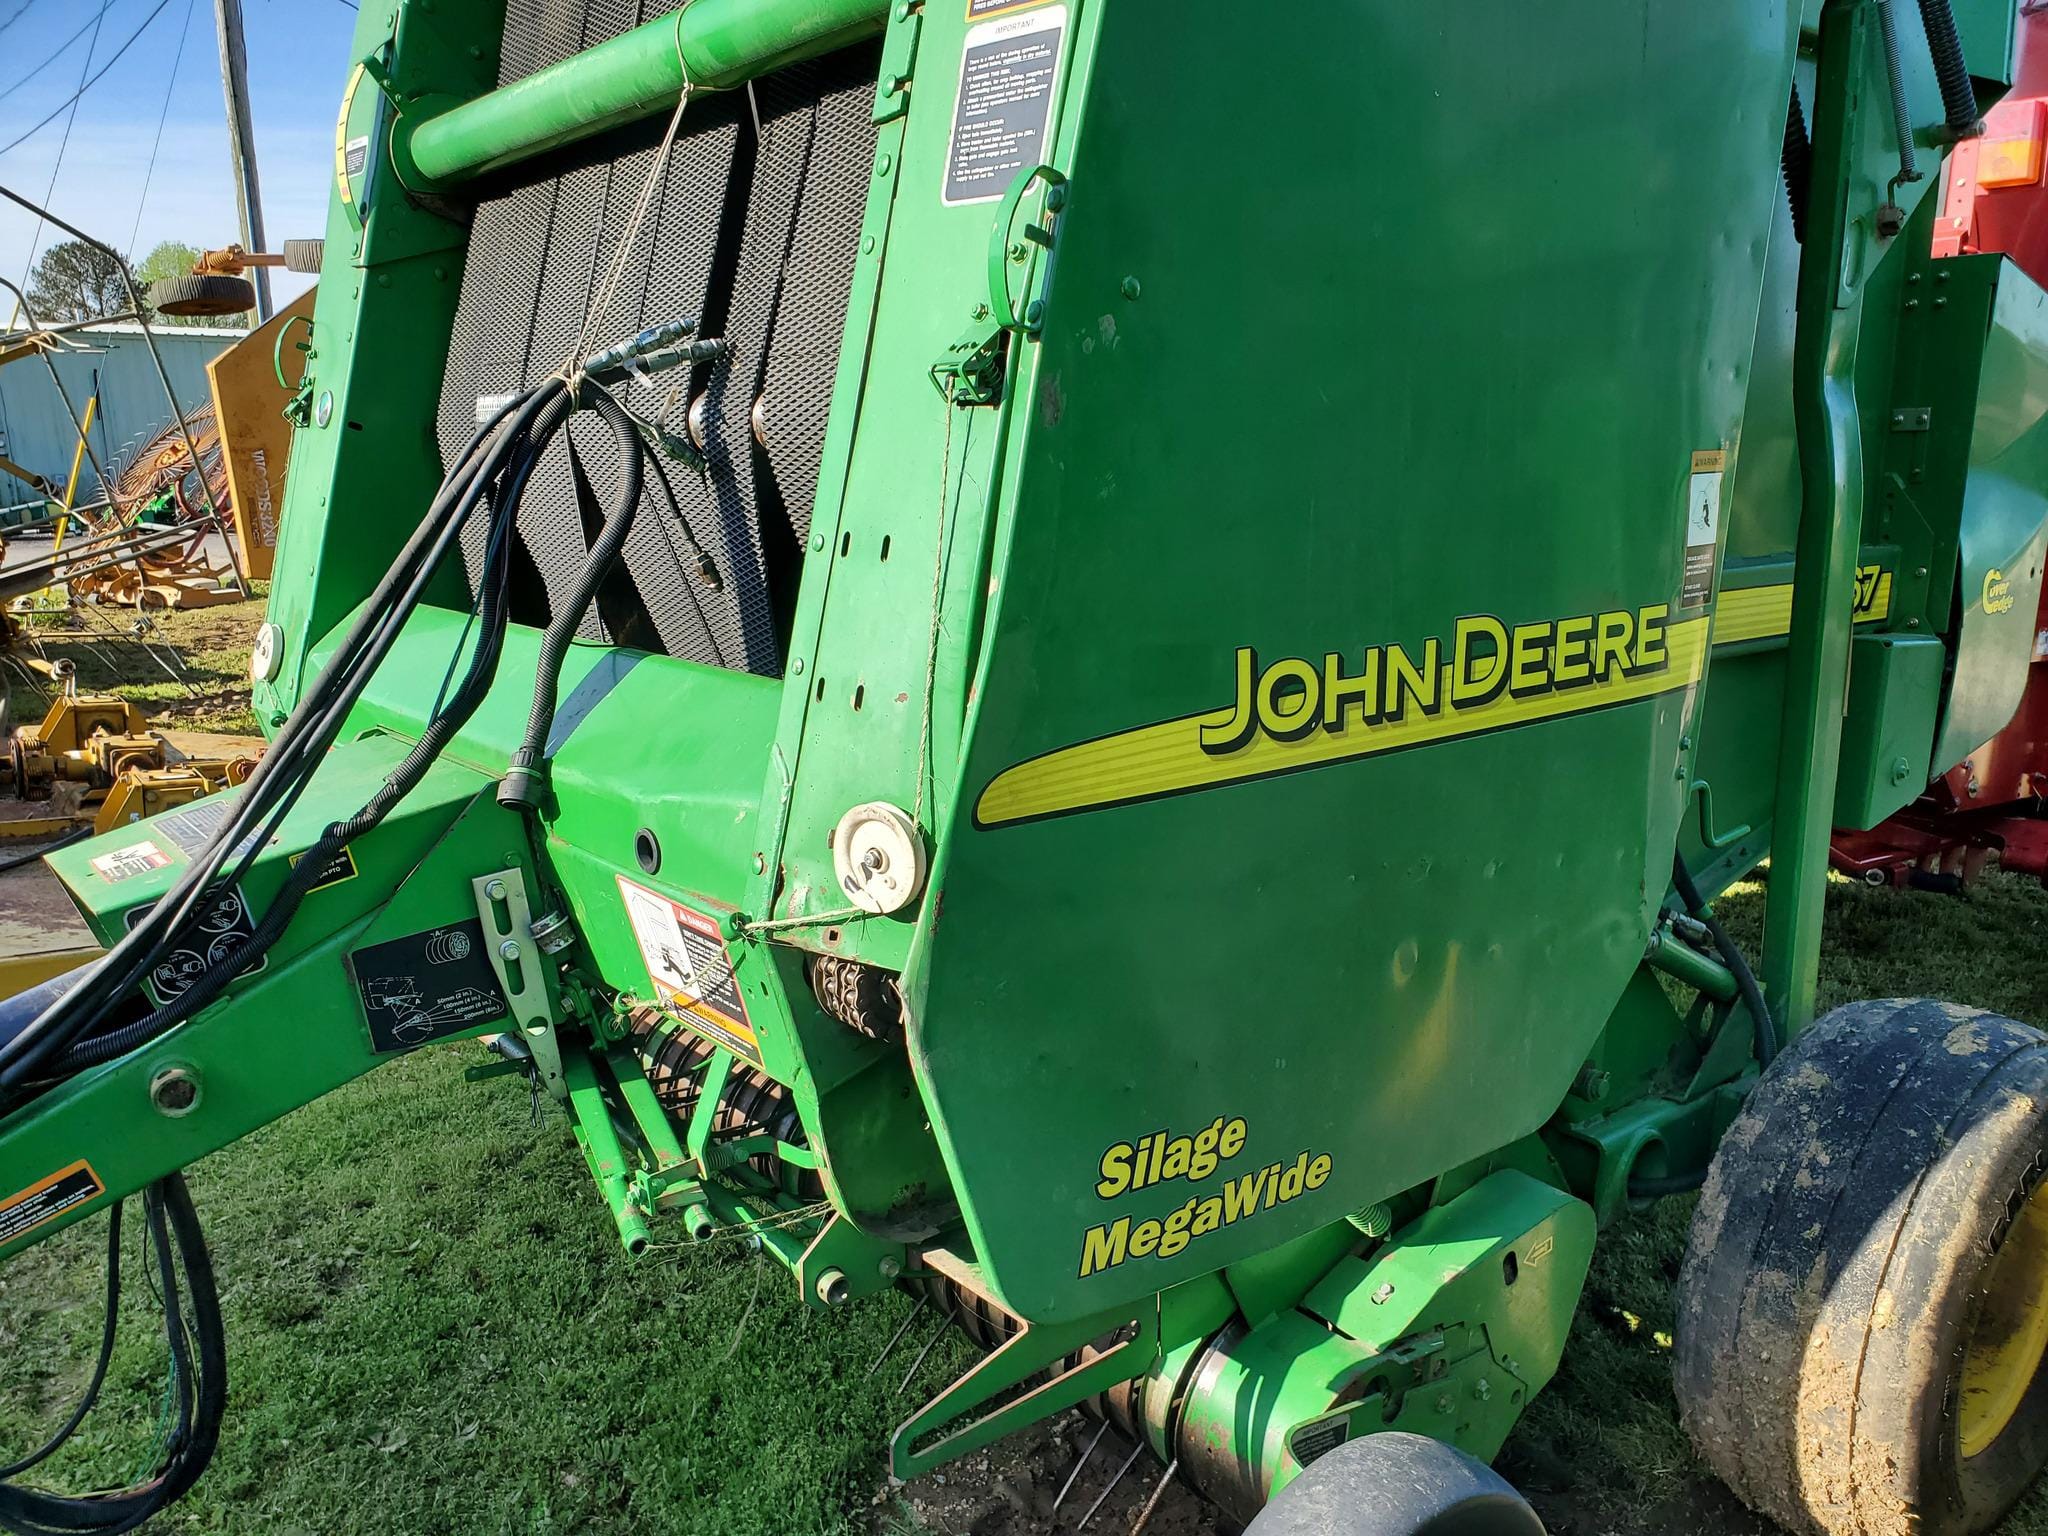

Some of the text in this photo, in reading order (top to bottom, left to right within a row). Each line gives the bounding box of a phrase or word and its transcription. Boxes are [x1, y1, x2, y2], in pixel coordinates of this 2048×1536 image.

[995, 18, 1035, 34] IMPORTANT
[1200, 604, 1670, 755] JOHN DEERE
[1095, 1114, 1248, 1200] Silage
[1077, 1150, 1333, 1279] MegaWide
